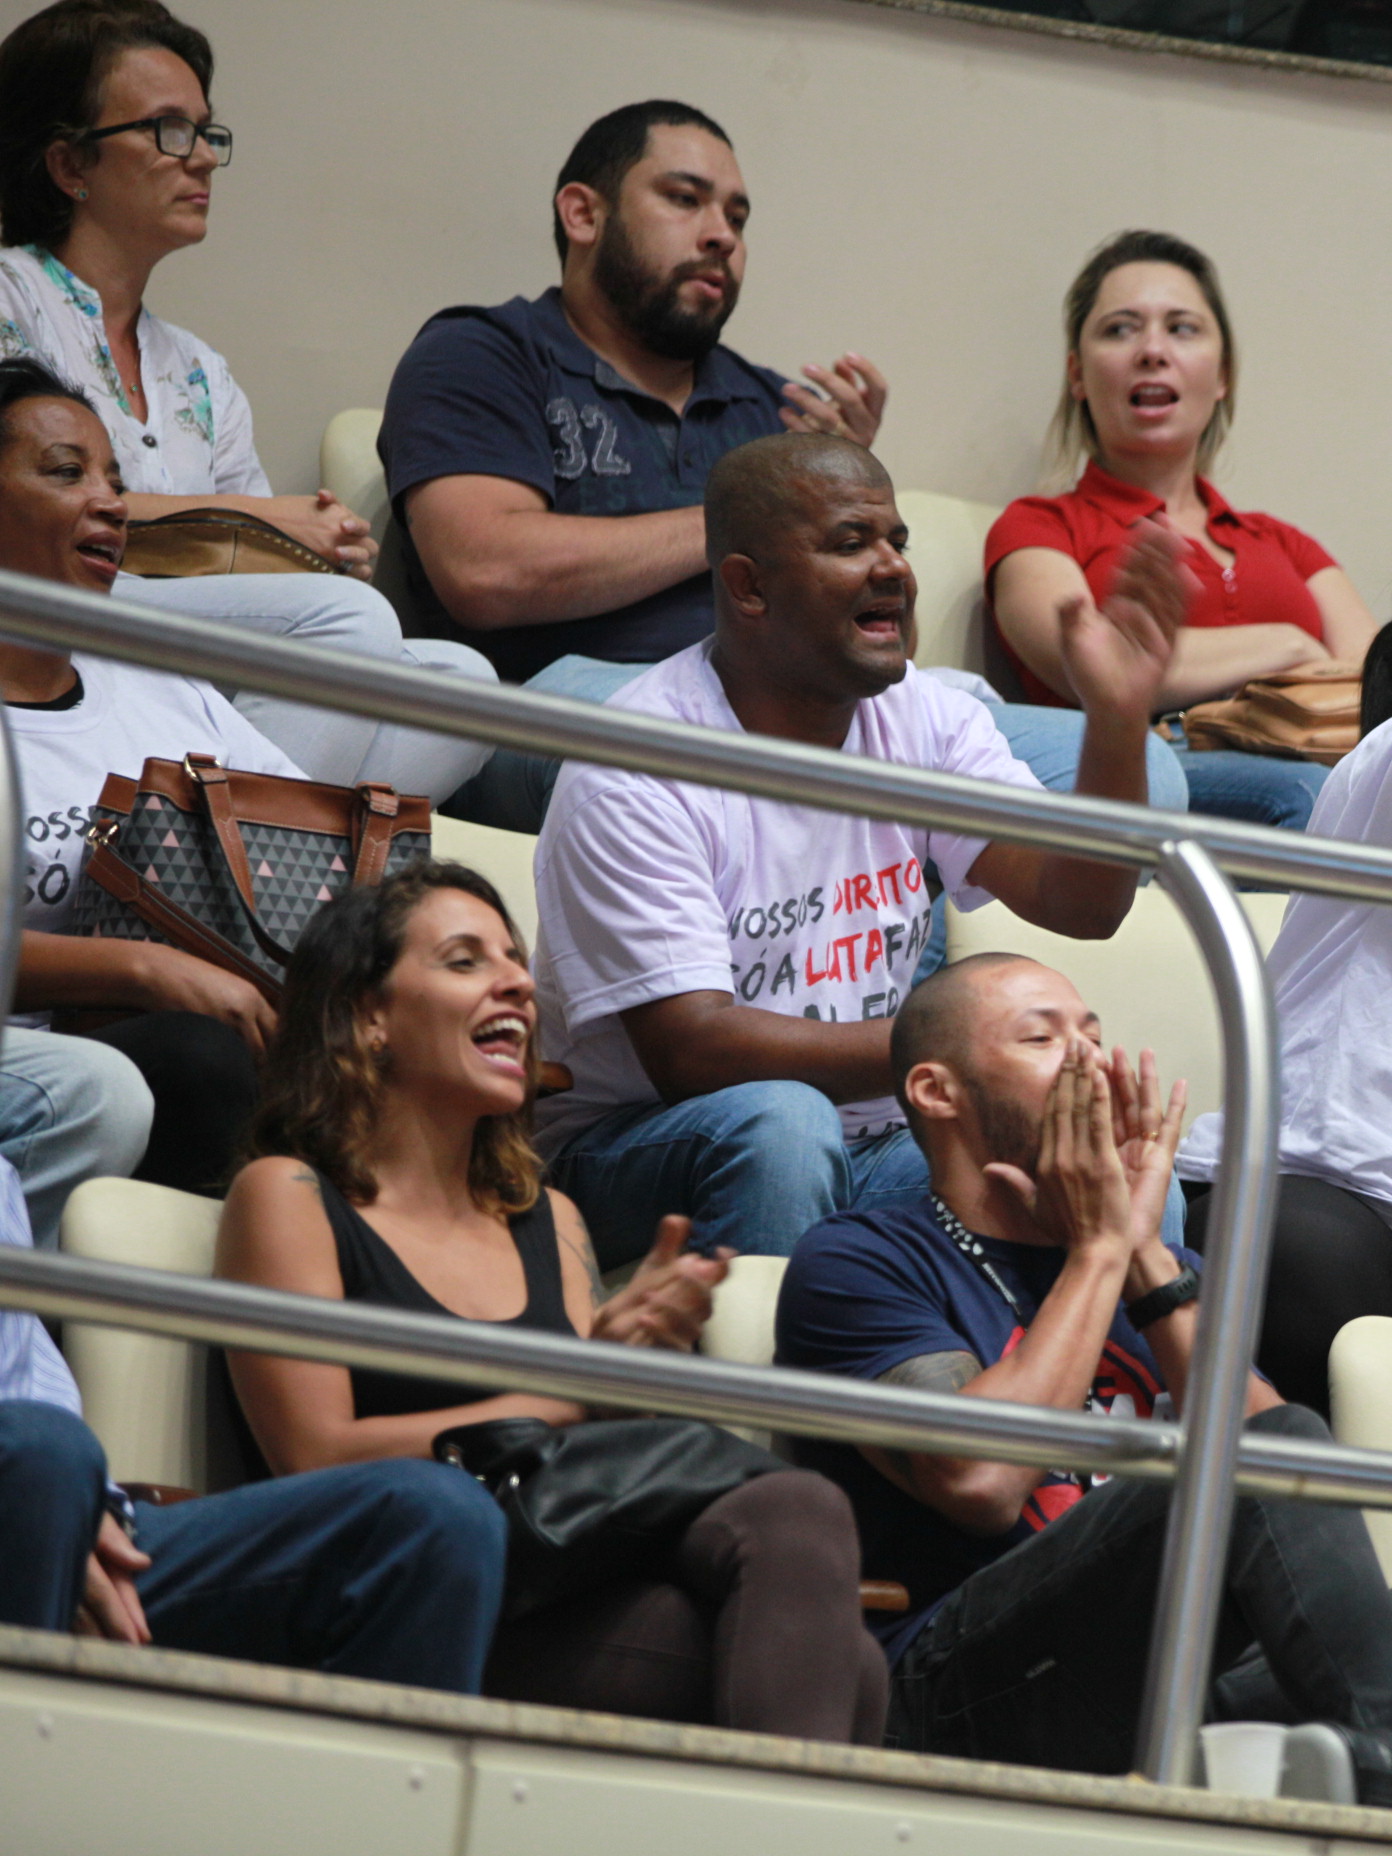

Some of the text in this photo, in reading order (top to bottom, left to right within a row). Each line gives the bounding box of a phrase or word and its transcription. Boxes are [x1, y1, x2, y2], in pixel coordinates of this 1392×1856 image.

[546, 397, 631, 480] 32
[770, 953, 797, 995] A
[805, 928, 883, 986] LUTA
